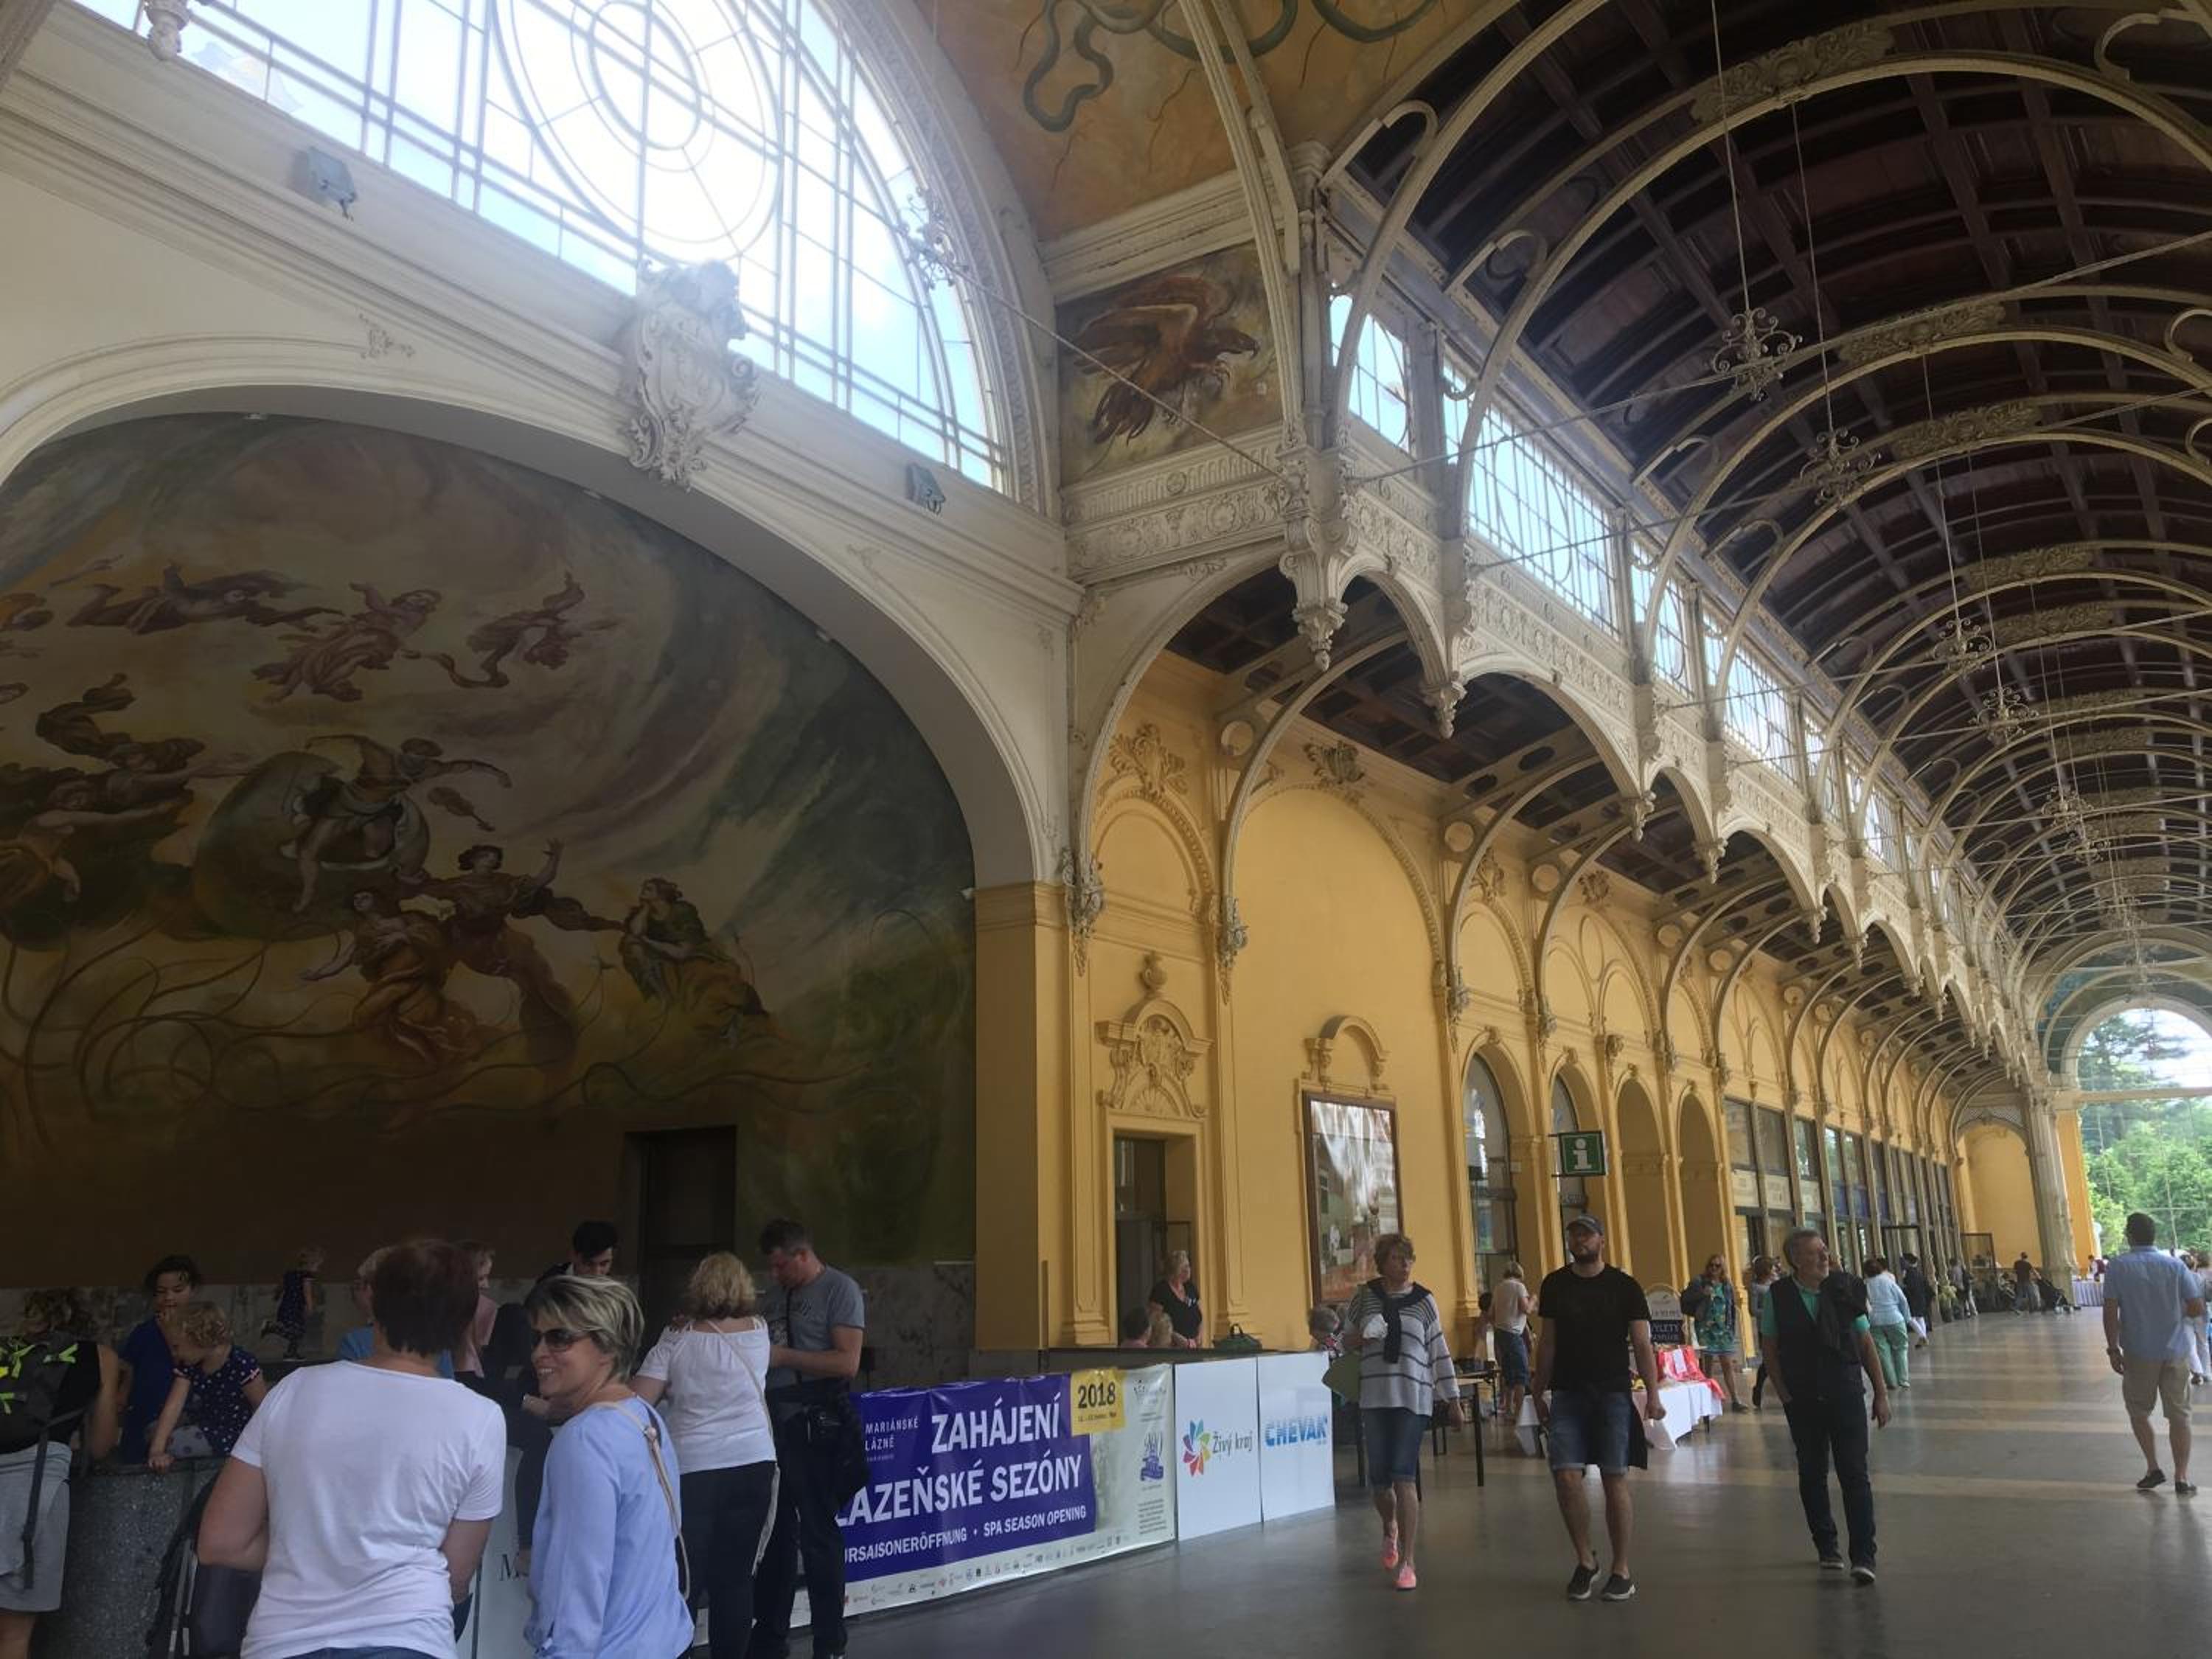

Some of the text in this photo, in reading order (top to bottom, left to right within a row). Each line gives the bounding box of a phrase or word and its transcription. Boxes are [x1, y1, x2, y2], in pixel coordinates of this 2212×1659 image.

[1078, 1381, 1116, 1409] 2018
[865, 1415, 919, 1434] MARIÁNSKÉ
[931, 1391, 1061, 1453] ZAHÁJENÍ
[1265, 1415, 1328, 1447] CHEVAK
[1213, 1430, 1253, 1455] Živý kraj
[990, 1449, 1082, 1502] SEZÓNY
[984, 1520, 1002, 1537] SPA
[1004, 1512, 1045, 1533] SEASON
[1047, 1505, 1086, 1526] OPENING
